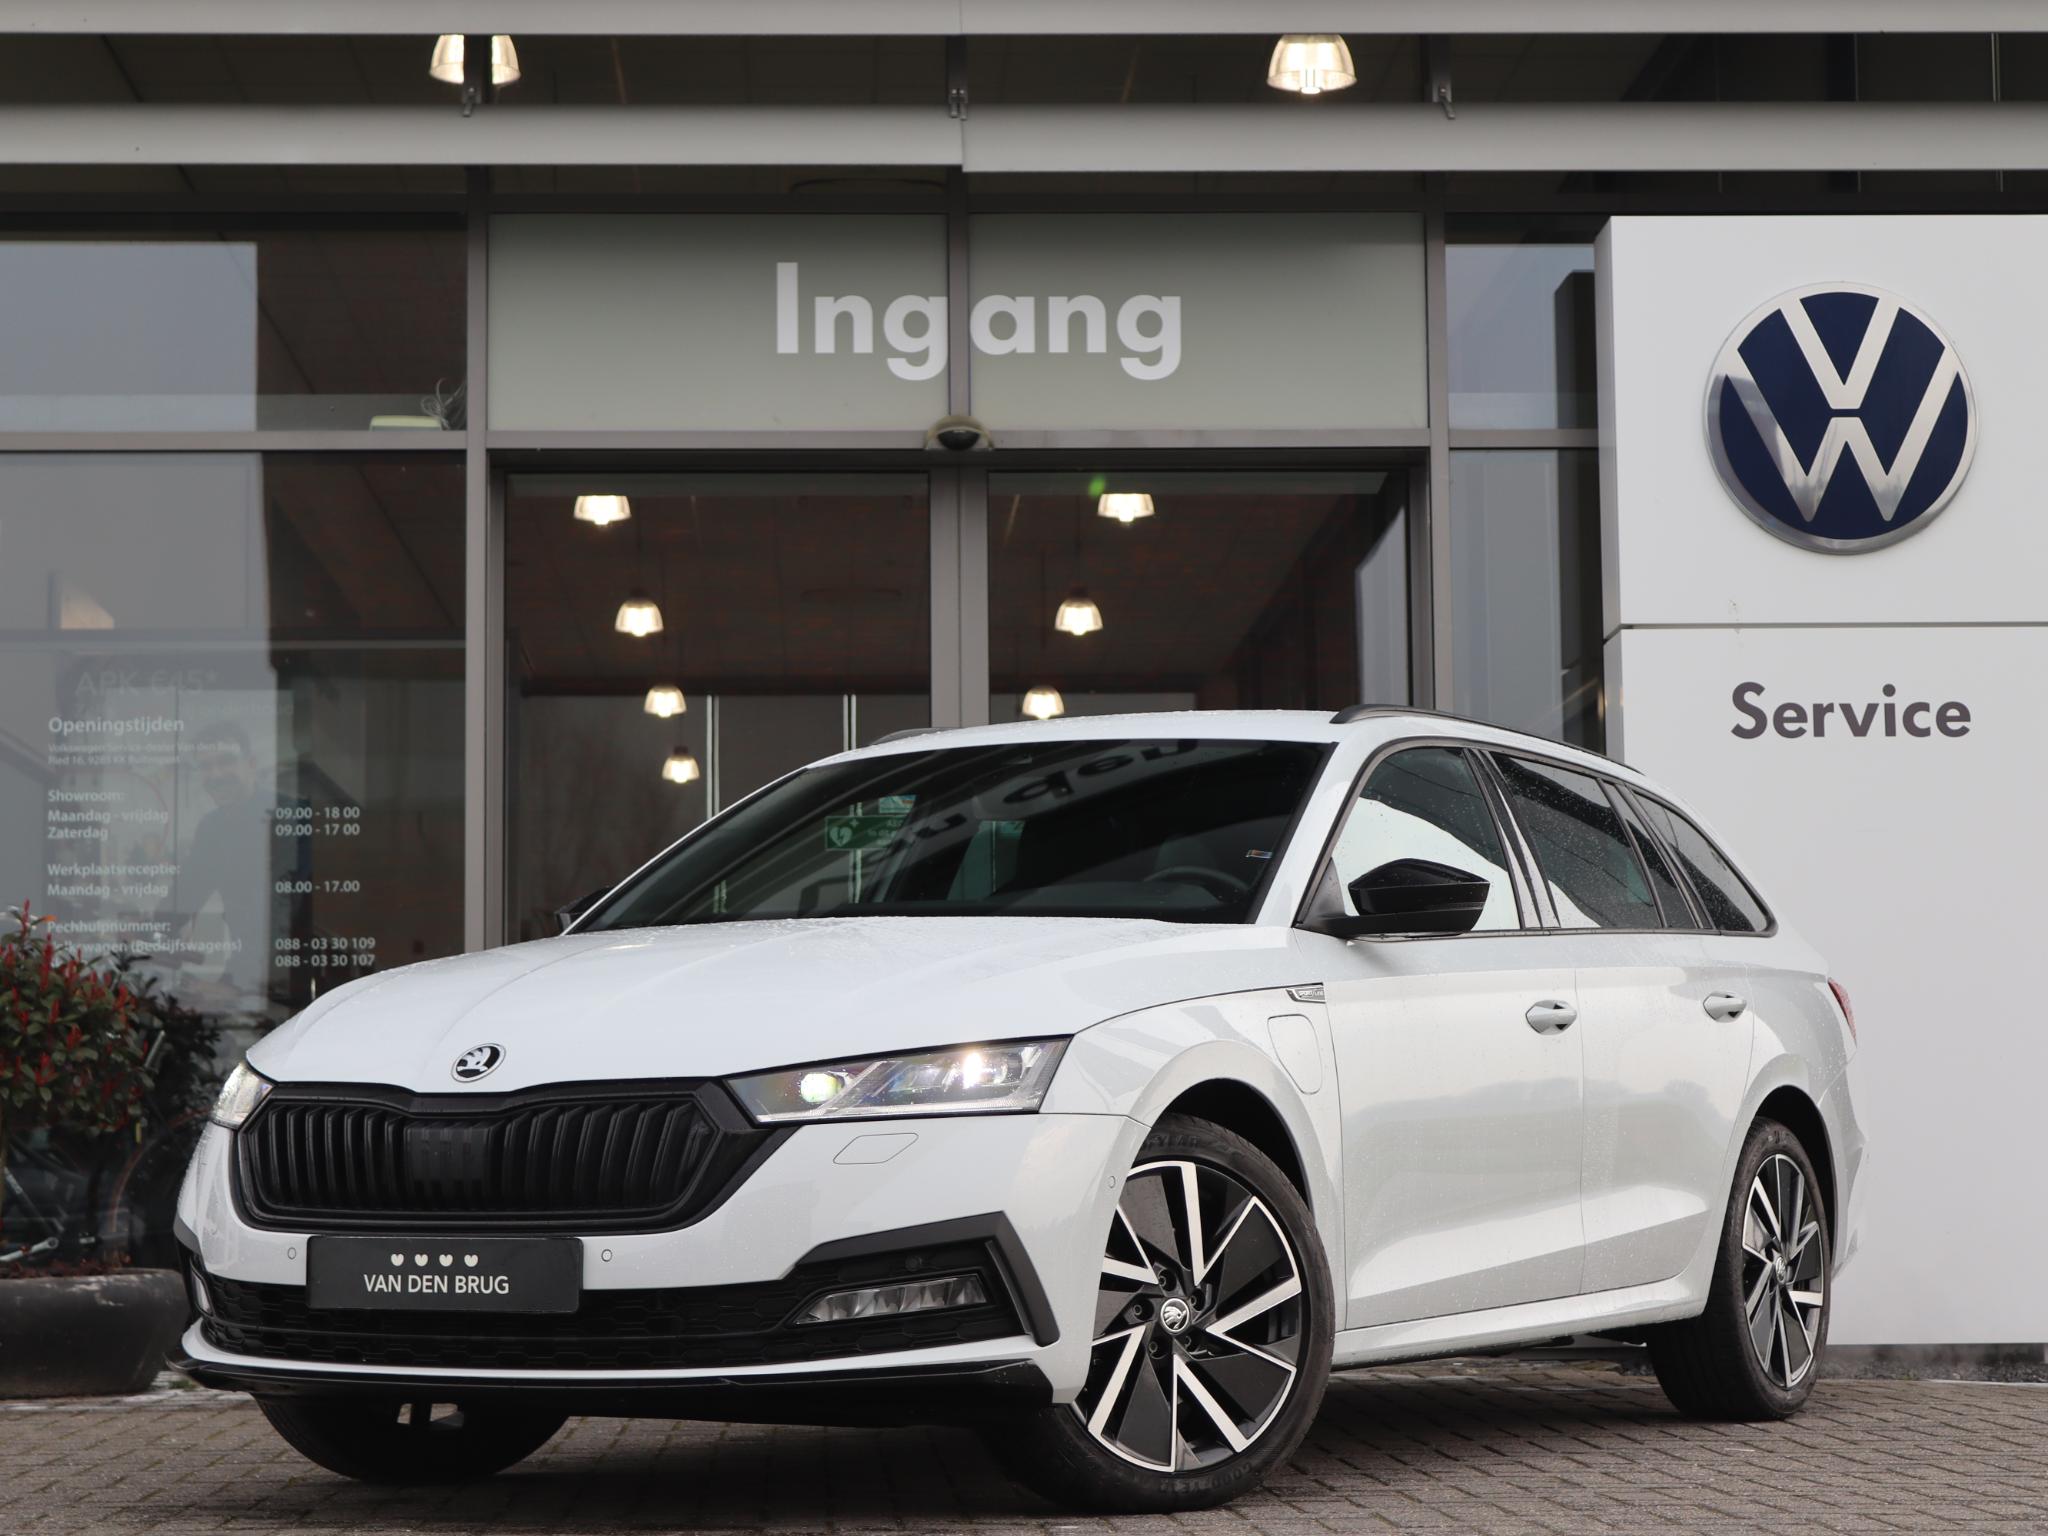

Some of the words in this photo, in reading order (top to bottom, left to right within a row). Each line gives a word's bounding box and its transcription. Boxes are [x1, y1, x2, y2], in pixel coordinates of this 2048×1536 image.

[777, 262, 1182, 381] Ingang
[1731, 681, 1972, 740] Service
[48, 715, 185, 737] Openingstijden
[48, 809, 110, 825] Maandag
[121, 808, 169, 825] vrijdag
[275, 807, 313, 820] 09.00
[48, 826, 109, 841] Zaterdag
[275, 823, 313, 836] 09.00
[47, 862, 181, 879] Werkplaatsreceptie:
[47, 882, 110, 899] Maandag
[121, 881, 169, 898] vrijdag
[275, 880, 313, 893] 08.00
[323, 880, 360, 893] 17.00
[275, 937, 301, 951] 088
[311, 937, 328, 950] 03
[331, 937, 348, 950] 30
[351, 936, 376, 950] 109
[275, 954, 301, 967] 088
[311, 954, 328, 967] 03
[331, 954, 348, 967] 30
[351, 953, 376, 967] 107
[363, 1274, 402, 1293] VAN
[407, 1274, 449, 1294] DEN
[455, 1275, 510, 1295] BRUG
